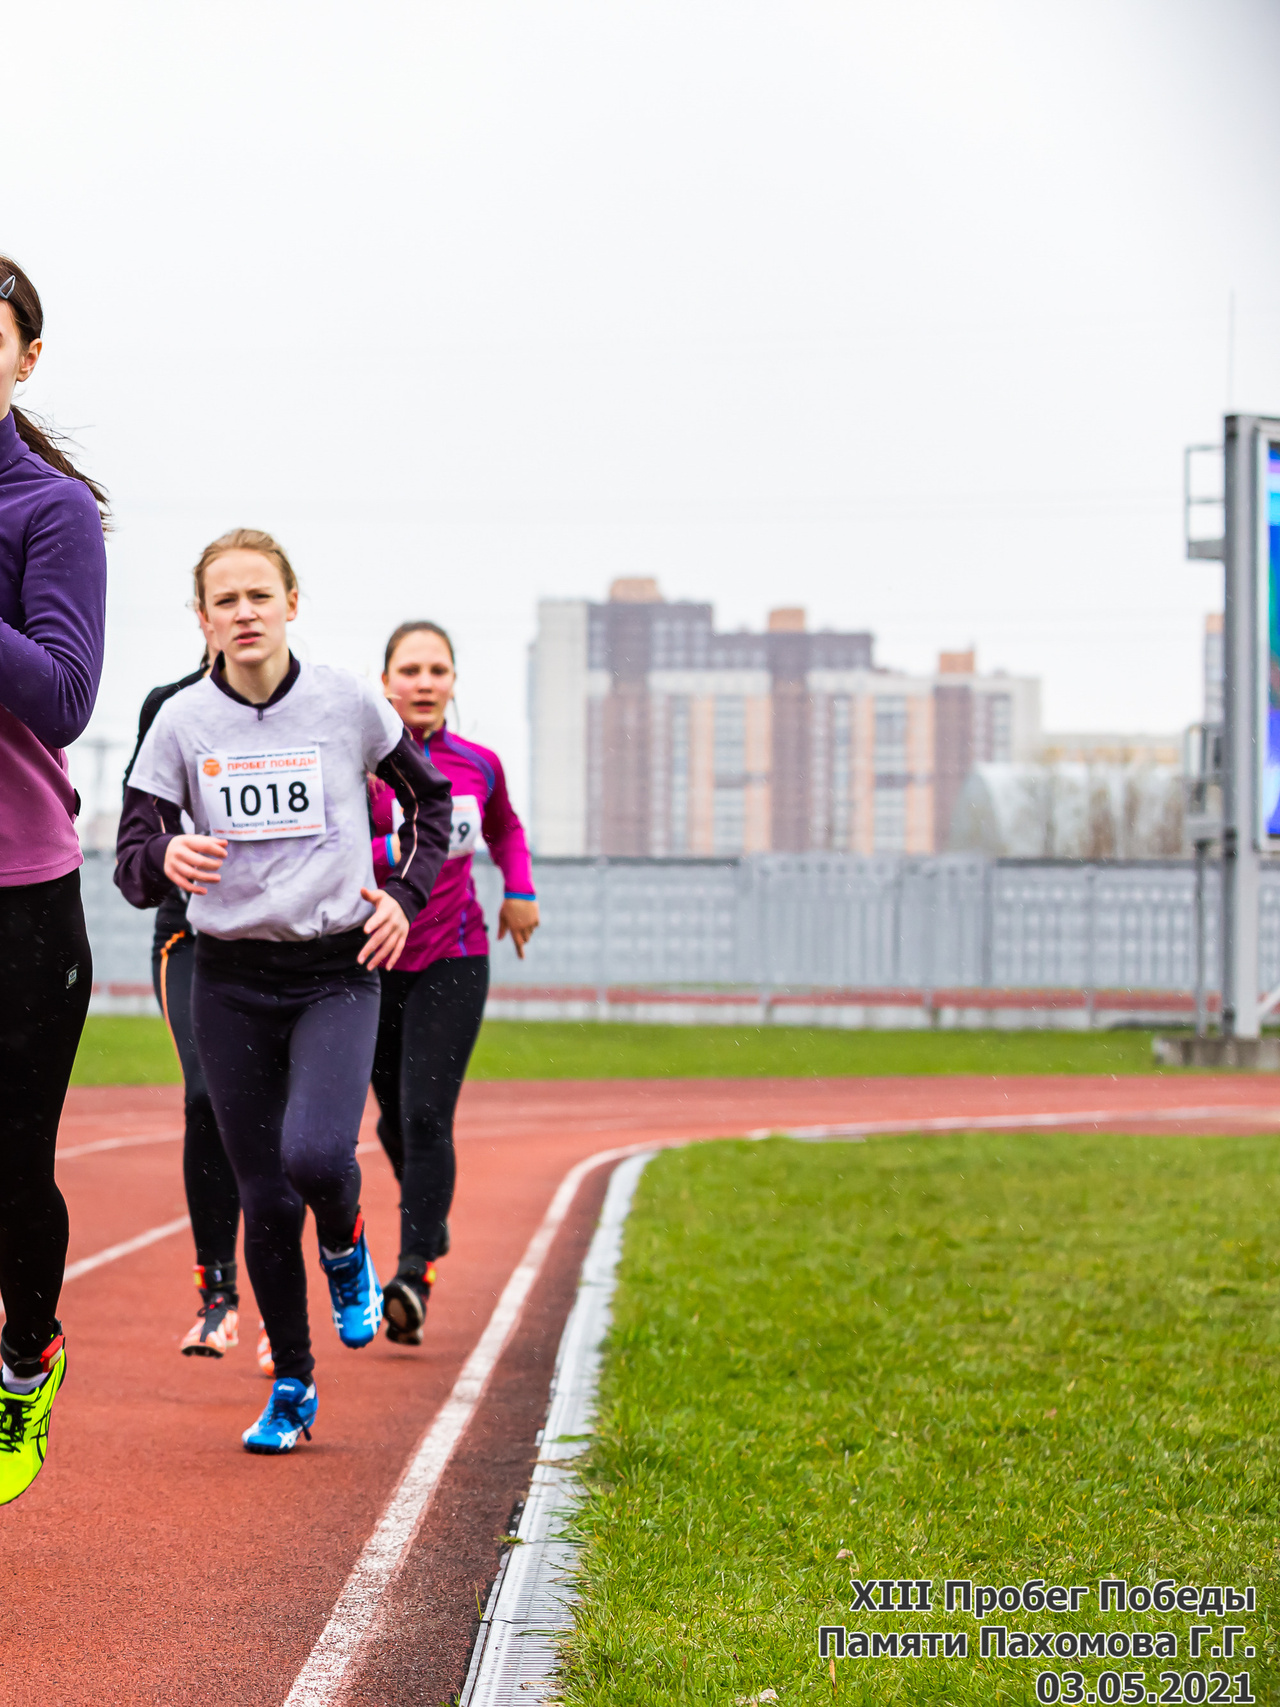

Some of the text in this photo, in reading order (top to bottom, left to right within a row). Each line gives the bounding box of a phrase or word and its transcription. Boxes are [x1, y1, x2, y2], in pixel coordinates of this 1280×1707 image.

[227, 757, 318, 771] ПРОБЕГ ПОБЕДЫ
[219, 781, 310, 817] 1018
